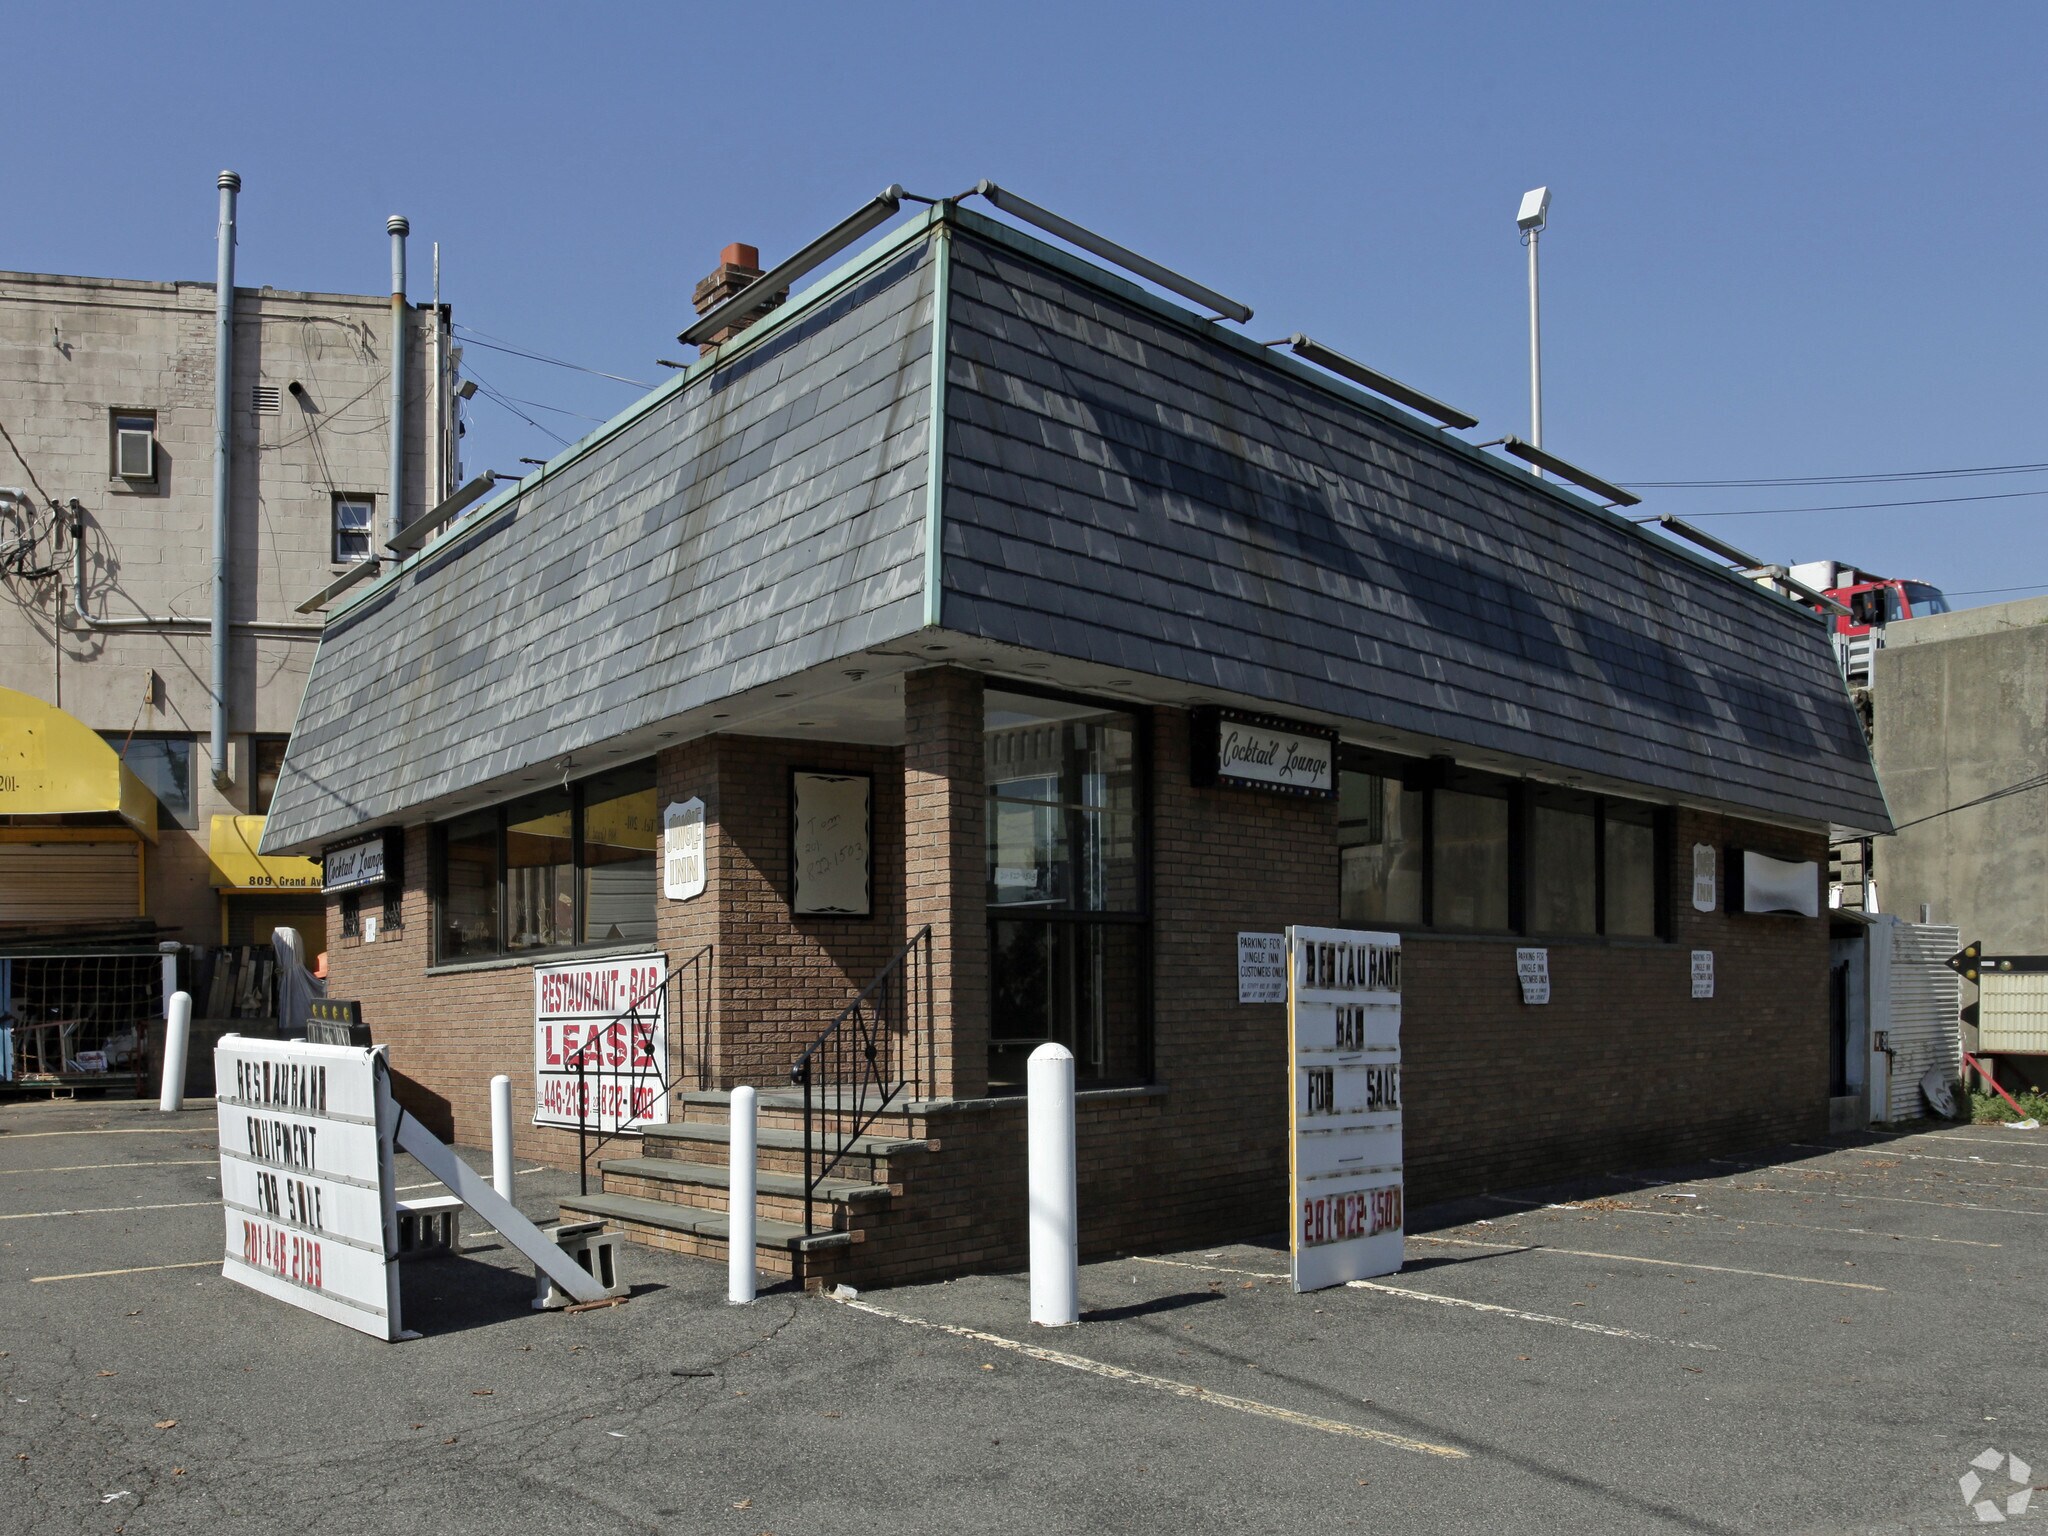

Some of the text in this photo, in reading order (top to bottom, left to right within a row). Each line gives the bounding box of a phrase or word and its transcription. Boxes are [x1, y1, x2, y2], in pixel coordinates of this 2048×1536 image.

[1223, 731, 1327, 783] Cocktail Lounge
[249, 876, 323, 886] 809 Grand Av
[328, 853, 356, 883] Cocktail
[669, 855, 699, 885] INN
[1240, 937, 1281, 950] PARKING FOR
[1243, 952, 1279, 964] JINGLE INN
[1240, 966, 1284, 978] CUSTOMERS ONLY
[542, 970, 619, 1013] RESTAURANT
[629, 967, 657, 1009] BAR
[545, 1023, 653, 1067] LEASE
[1367, 1067, 1397, 1107] SALE
